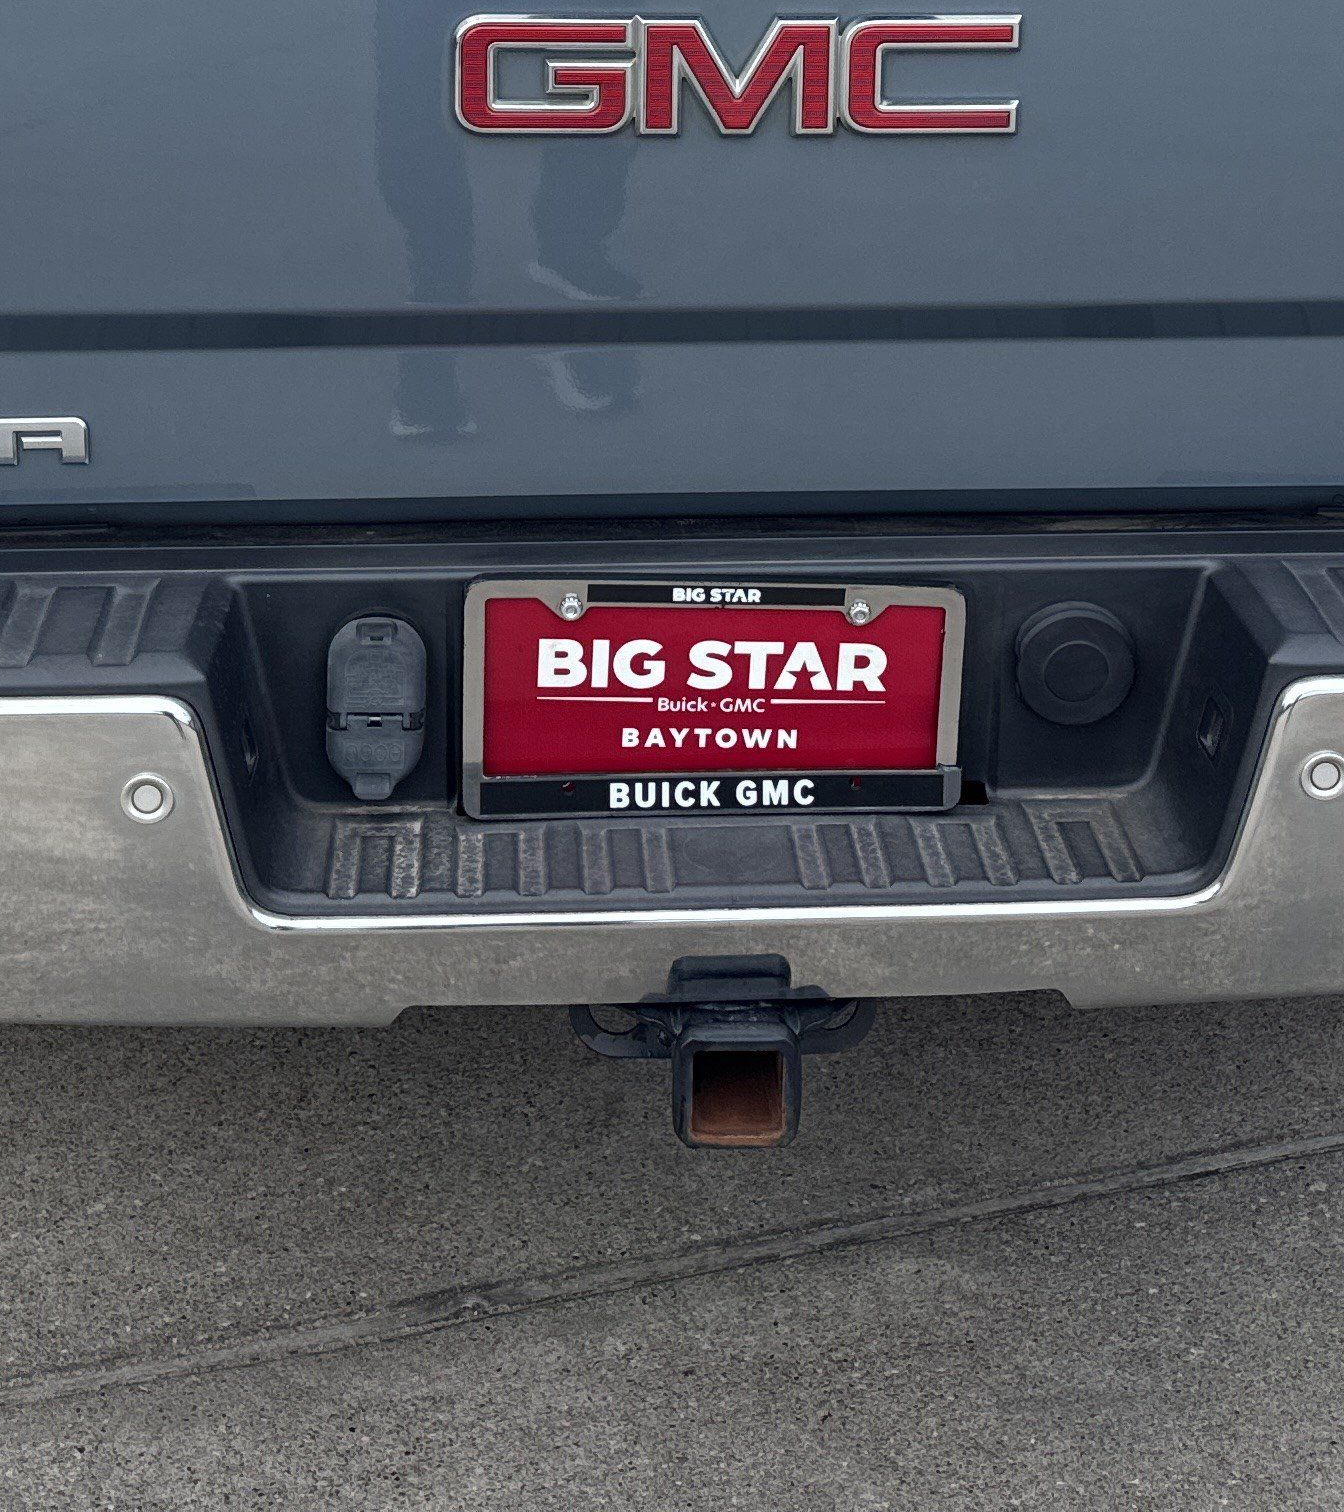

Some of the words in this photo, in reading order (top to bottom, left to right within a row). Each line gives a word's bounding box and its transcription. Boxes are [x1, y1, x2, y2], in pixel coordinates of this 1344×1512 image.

[456, 14, 1023, 136] GMC
[672, 587, 706, 603] BIG
[709, 588, 762, 604] STAR
[536, 638, 666, 690] BIG
[687, 640, 887, 692] STAR
[657, 696, 709, 714] Buick
[719, 697, 766, 714] GMC
[621, 727, 798, 750] BAYTOWN
[609, 781, 721, 810] BUICK
[736, 779, 815, 807] GMC
